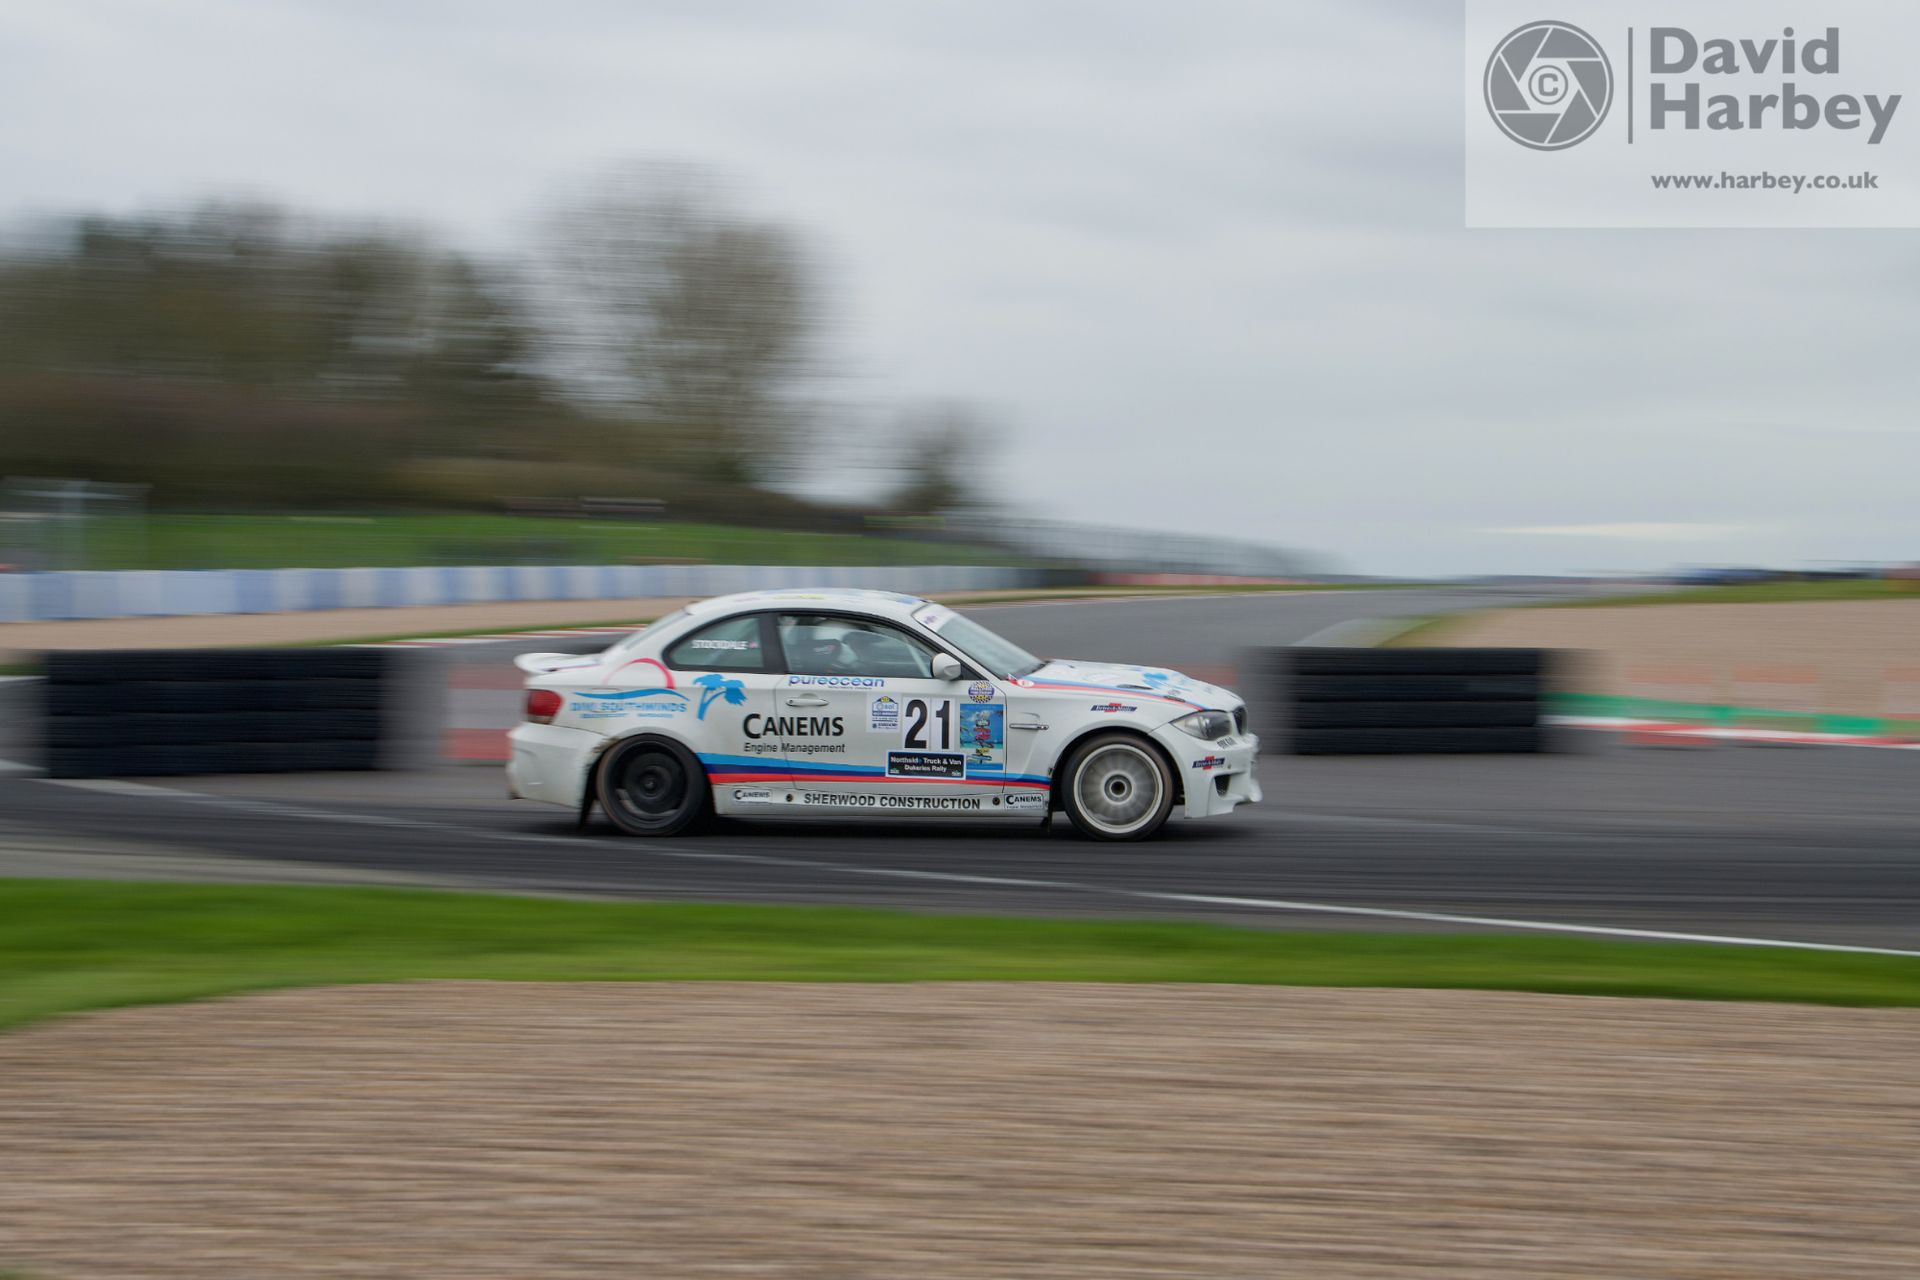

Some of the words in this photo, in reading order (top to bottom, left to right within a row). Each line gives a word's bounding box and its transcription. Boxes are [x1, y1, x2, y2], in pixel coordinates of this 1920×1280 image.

[788, 676, 885, 688] pureocean
[904, 699, 950, 750] 21
[743, 742, 778, 755] Engine
[781, 742, 846, 755] Management
[890, 756, 923, 764] Northsid
[924, 757, 942, 765] Truck
[804, 793, 876, 806] SHERWOOD
[879, 796, 981, 809] CONSTRUCTION
